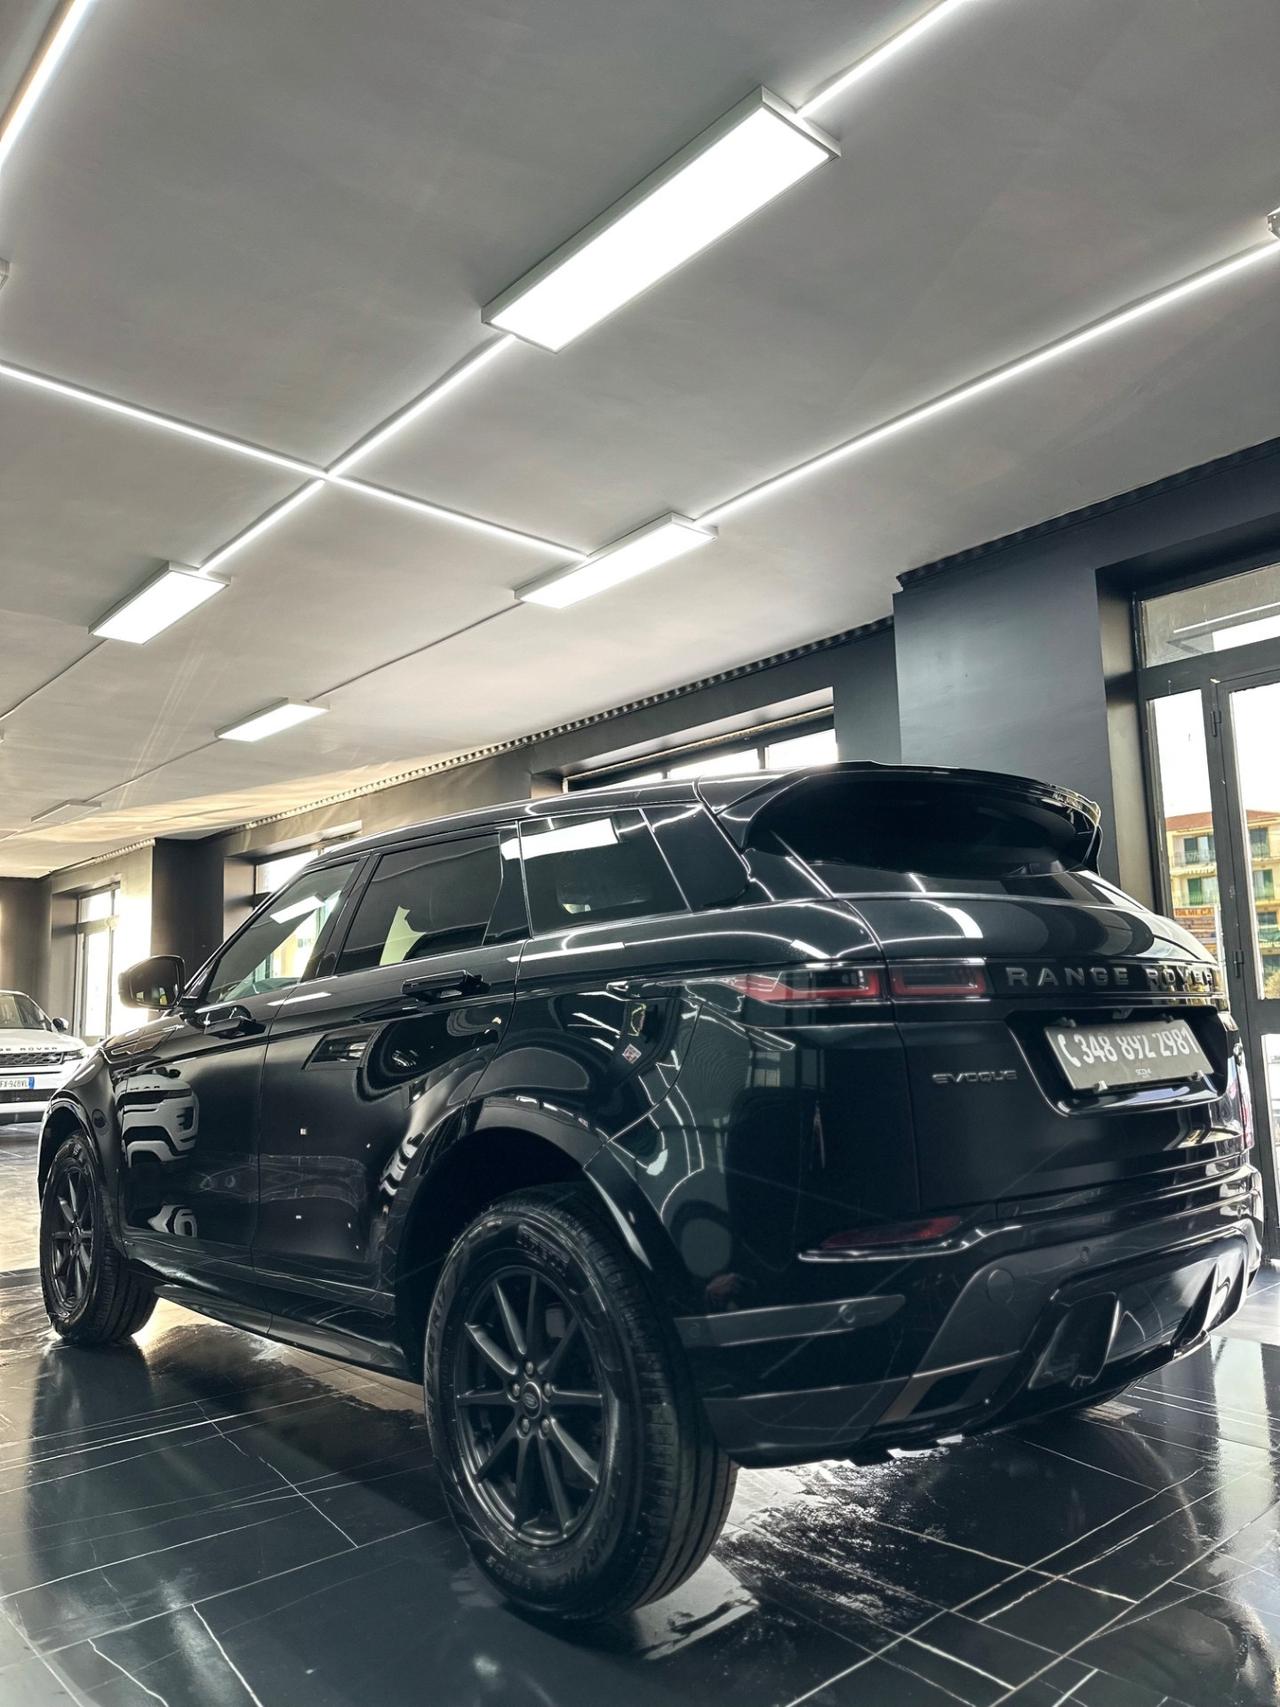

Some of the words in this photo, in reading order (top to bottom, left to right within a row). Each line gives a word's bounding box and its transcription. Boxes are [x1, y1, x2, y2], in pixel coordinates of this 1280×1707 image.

[1005, 966, 1129, 987] RANGE
[1144, 966, 1214, 988] ROVER
[1073, 1033, 1119, 1064] 348
[1115, 1034, 1157, 1061] 892
[1152, 1026, 1200, 1057] 2981
[931, 1070, 1018, 1084] EVOQUE
